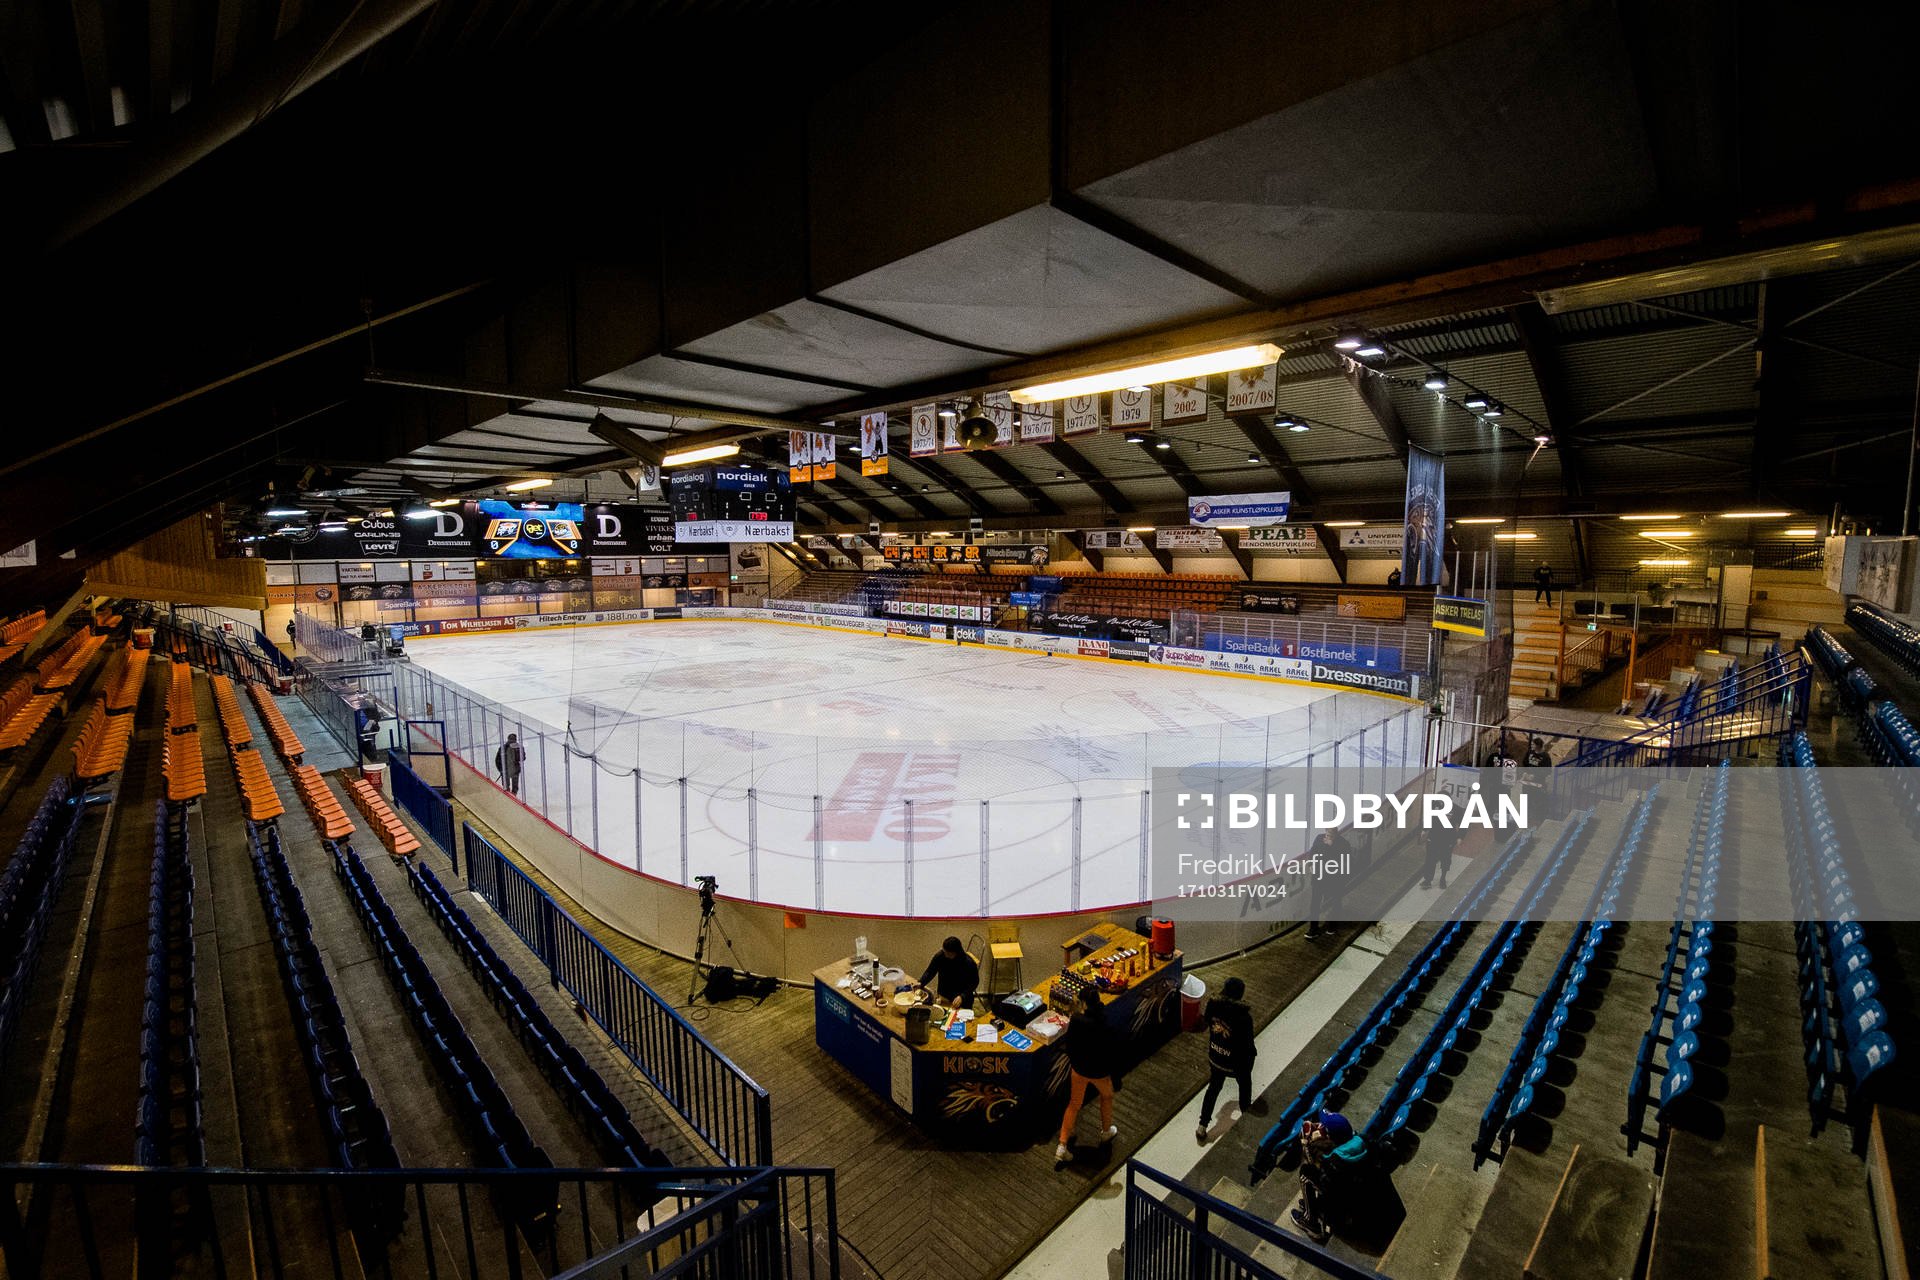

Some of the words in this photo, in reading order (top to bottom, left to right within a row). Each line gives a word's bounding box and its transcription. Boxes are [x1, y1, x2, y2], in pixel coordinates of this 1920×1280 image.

[1229, 390, 1274, 407] 2007/08
[1174, 400, 1197, 415] 2002
[1120, 408, 1141, 421] 1979
[1066, 413, 1097, 430] 1977/78
[1023, 421, 1051, 435] 1976/77
[671, 473, 705, 484] nordialog
[1213, 507, 1231, 515] ASKER
[361, 520, 395, 529] Cubus
[689, 526, 714, 537] Nærbakst
[745, 525, 790, 536] Nærbakst
[1248, 527, 1307, 540] PEAB
[384, 600, 421, 609] SpareBank
[1435, 604, 1459, 617] ASKER
[503, 617, 514, 626] AS
[538, 615, 561, 623] Hitech
[562, 613, 587, 622] Energy
[607, 613, 637, 621] 1881.no
[1078, 639, 1109, 650] IKANO
[1110, 647, 1148, 657] Dressmann
[1226, 640, 1280, 654] SpareBank
[1287, 644, 1293, 656] 1
[1300, 646, 1357, 662] Østlandet
[1210, 660, 1231, 668] ARKEL
[1235, 662, 1255, 671] ARKEL
[1259, 665, 1281, 674] ARKEL
[1286, 668, 1309, 677] ARKEL
[1313, 666, 1410, 692] Dressmann
[943, 1056, 1010, 1073] KIOSK
